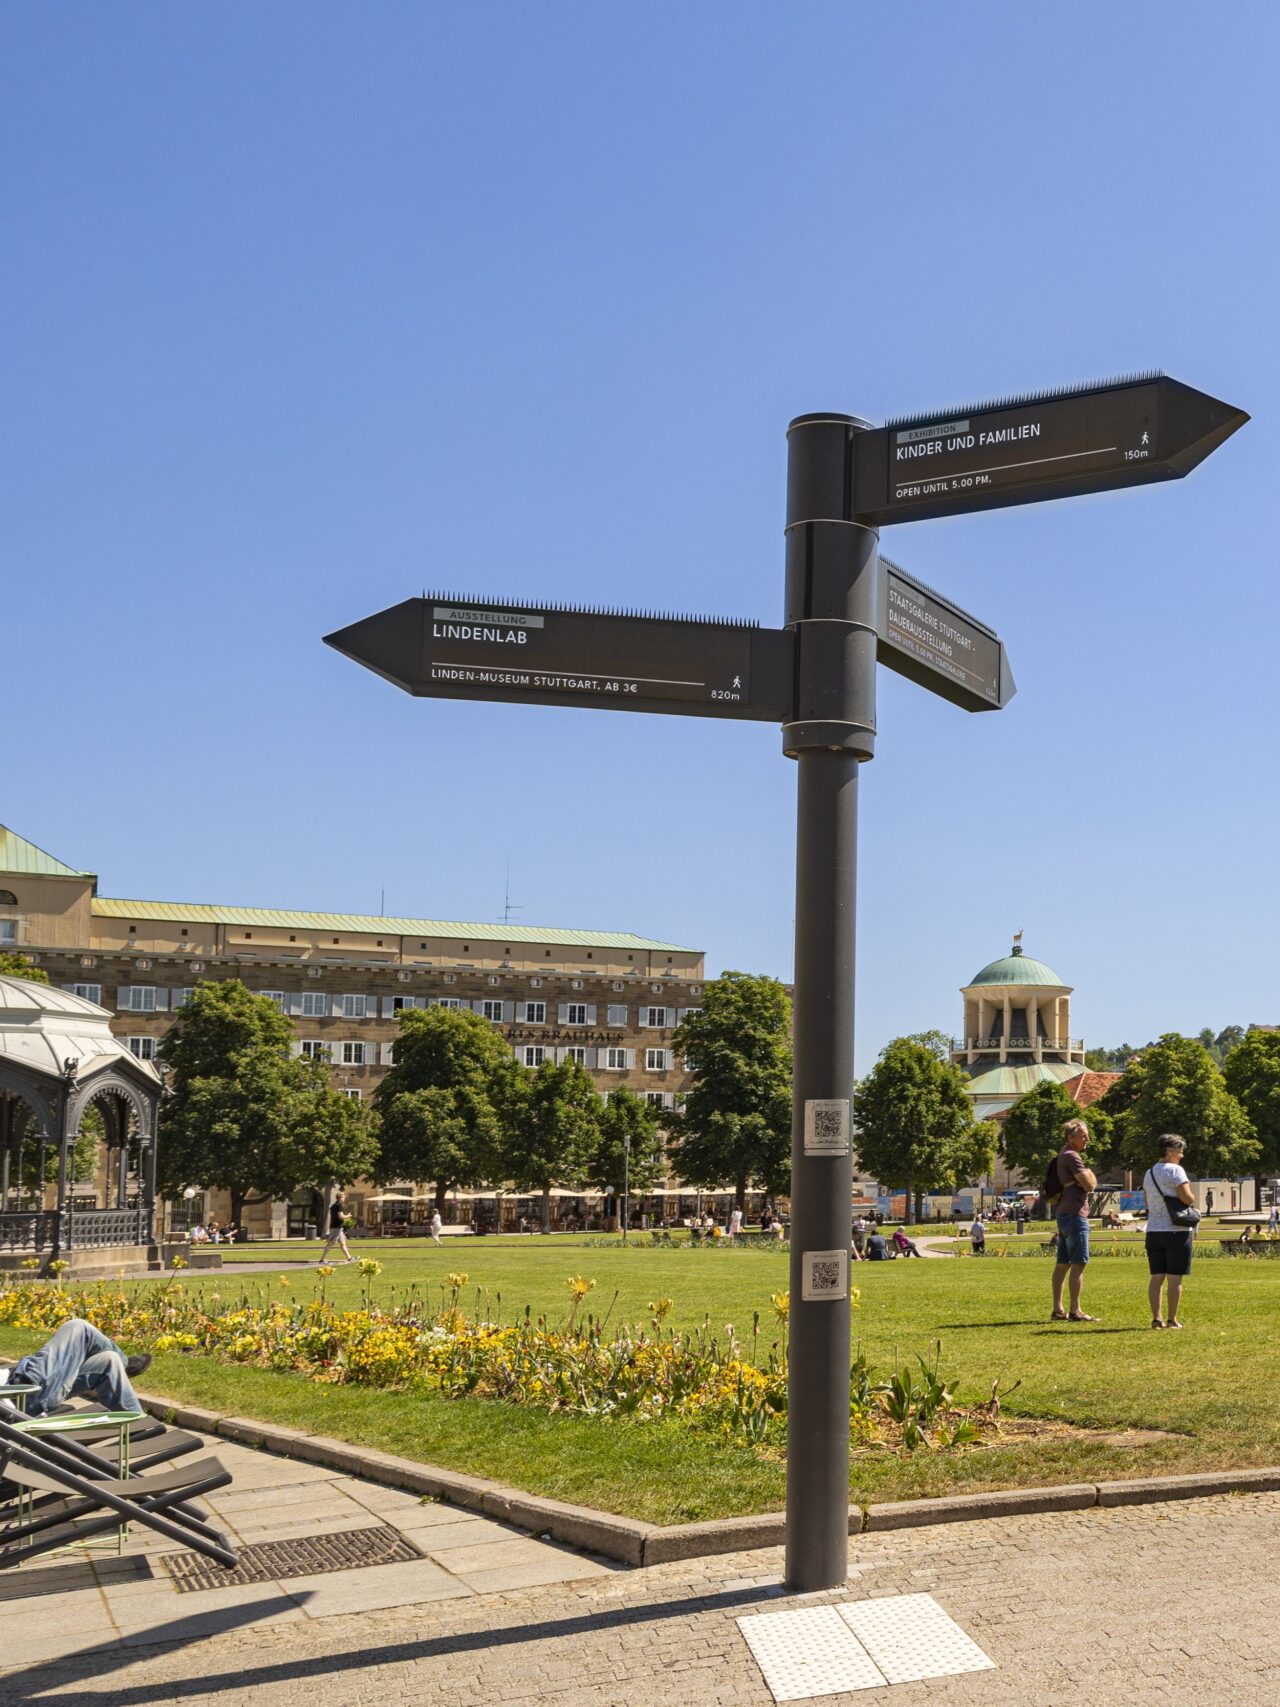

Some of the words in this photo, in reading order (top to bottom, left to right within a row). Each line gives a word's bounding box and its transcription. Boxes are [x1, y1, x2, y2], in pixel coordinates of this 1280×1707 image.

[896, 441, 942, 460] KINDER
[947, 435, 975, 451] UND
[979, 423, 1041, 446] FAMILIEN
[908, 424, 956, 440] EXHIBITION
[1124, 450, 1148, 460] 150m
[896, 486, 921, 498] OPEN
[923, 481, 949, 494] UNTIL
[952, 478, 973, 489] 5.00
[449, 610, 528, 625] AUSSTELLUNG
[889, 590, 938, 630] STAATSGALERIE
[940, 622, 972, 651] STUTTGART
[433, 624, 528, 644] LINDENLAB
[889, 609, 953, 656] DAUERAUSSTELLUNG
[431, 668, 530, 684] LINDEN-MUSEUM
[604, 682, 620, 692] AB
[624, 683, 638, 692] 3€
[711, 690, 740, 701] 820m
[541, 1030, 624, 1041] BRAUHAUS
